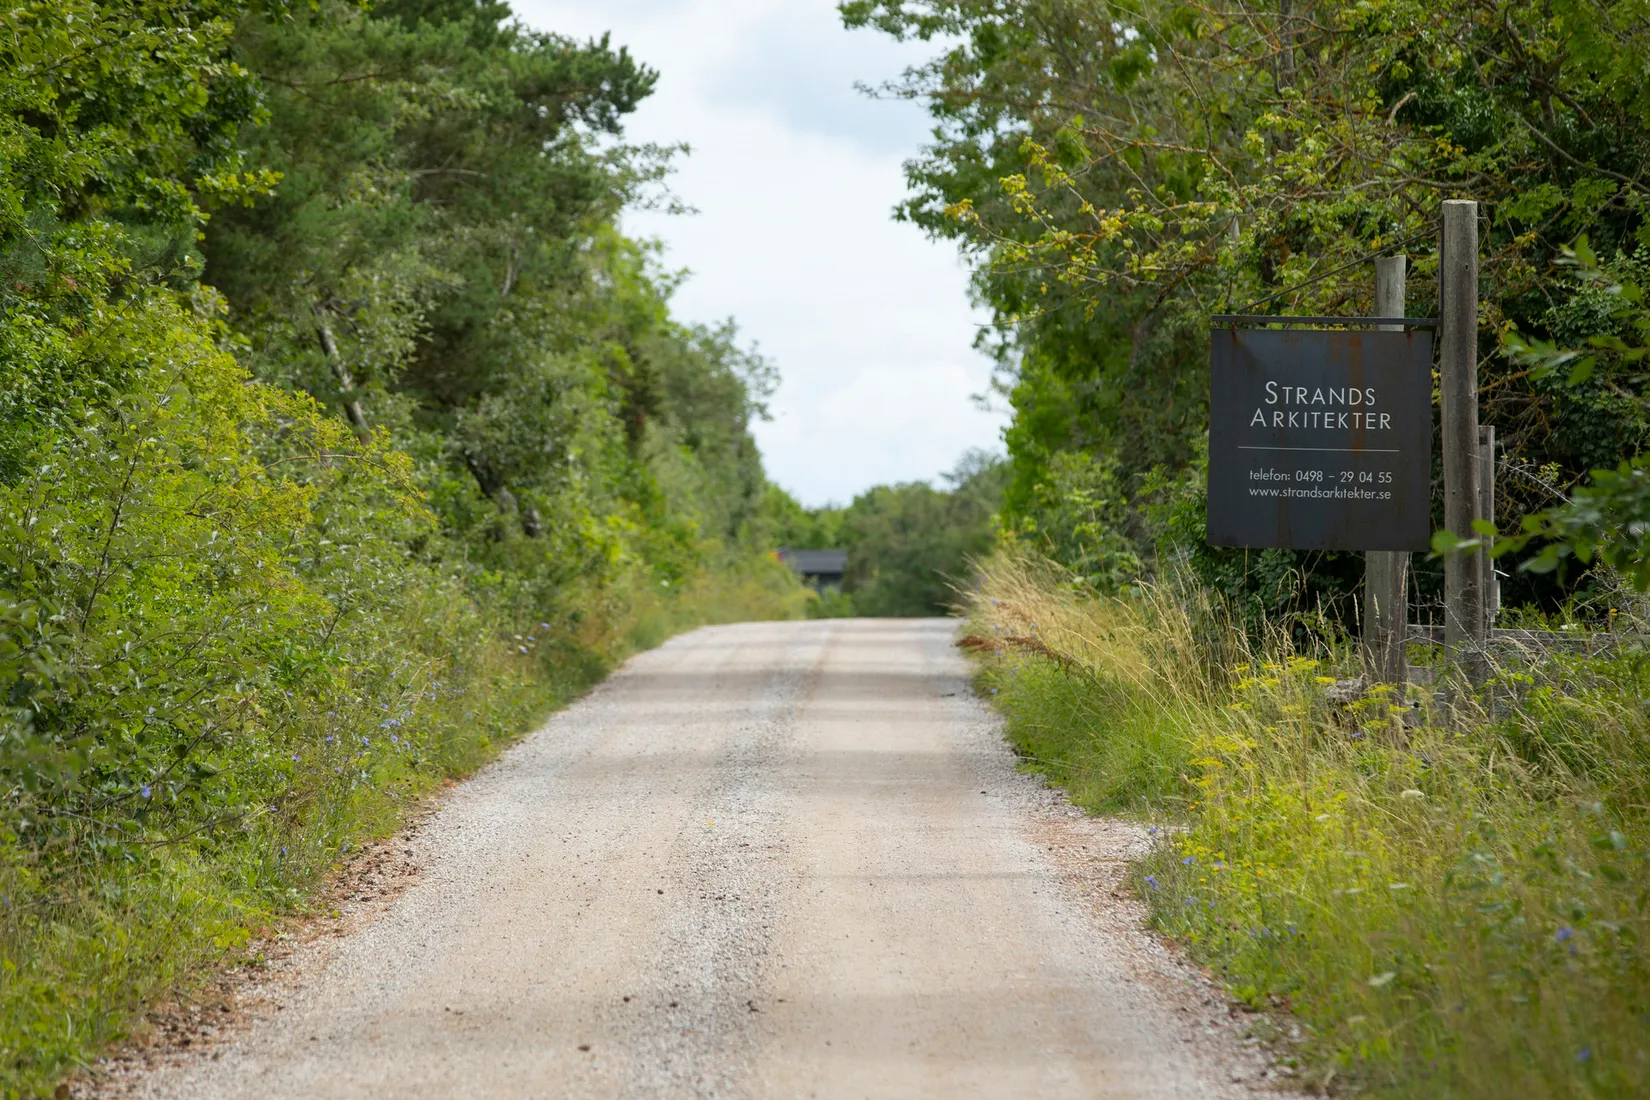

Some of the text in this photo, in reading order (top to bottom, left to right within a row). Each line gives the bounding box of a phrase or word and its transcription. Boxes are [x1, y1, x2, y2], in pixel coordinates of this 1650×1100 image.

[1264, 380, 1376, 406] STRANDS
[1249, 407, 1391, 430] ARKITEKTER
[1249, 468, 1291, 481] telefon:
[1295, 470, 1323, 482] 0498
[1340, 471, 1354, 483] 29
[1358, 471, 1373, 483] 04
[1378, 471, 1392, 484] 55
[1249, 486, 1392, 500] www.strandsarkitekter.se
